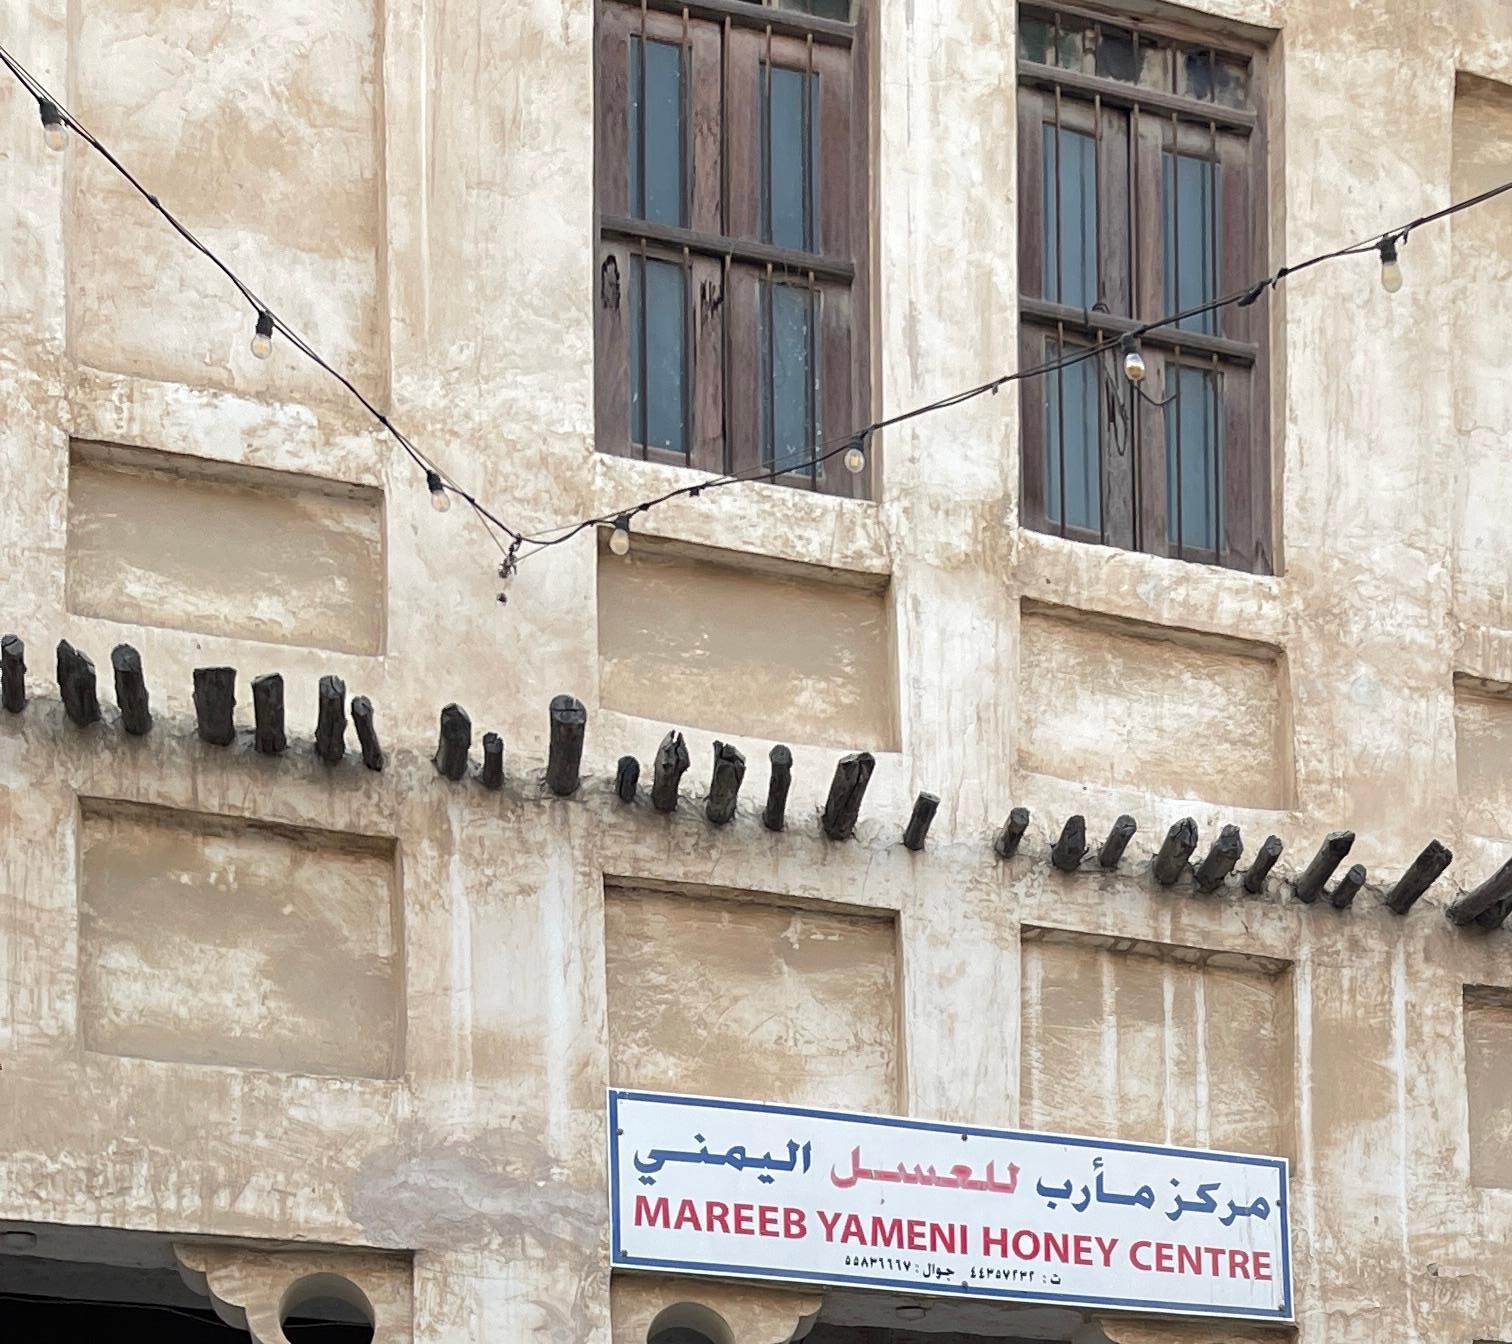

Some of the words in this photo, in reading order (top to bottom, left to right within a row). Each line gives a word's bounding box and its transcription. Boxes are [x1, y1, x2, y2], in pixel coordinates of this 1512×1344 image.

[633, 1132, 812, 1186] اليمني
[830, 1145, 1021, 1194] للعسل
[1035, 1157, 1156, 1213] مأرب
[1164, 1178, 1271, 1227] مركز
[633, 1194, 808, 1240] MAREEB
[815, 1209, 969, 1256] YAMENI
[982, 1226, 1119, 1267] HONEY
[1128, 1240, 1273, 1281] CENTRE
